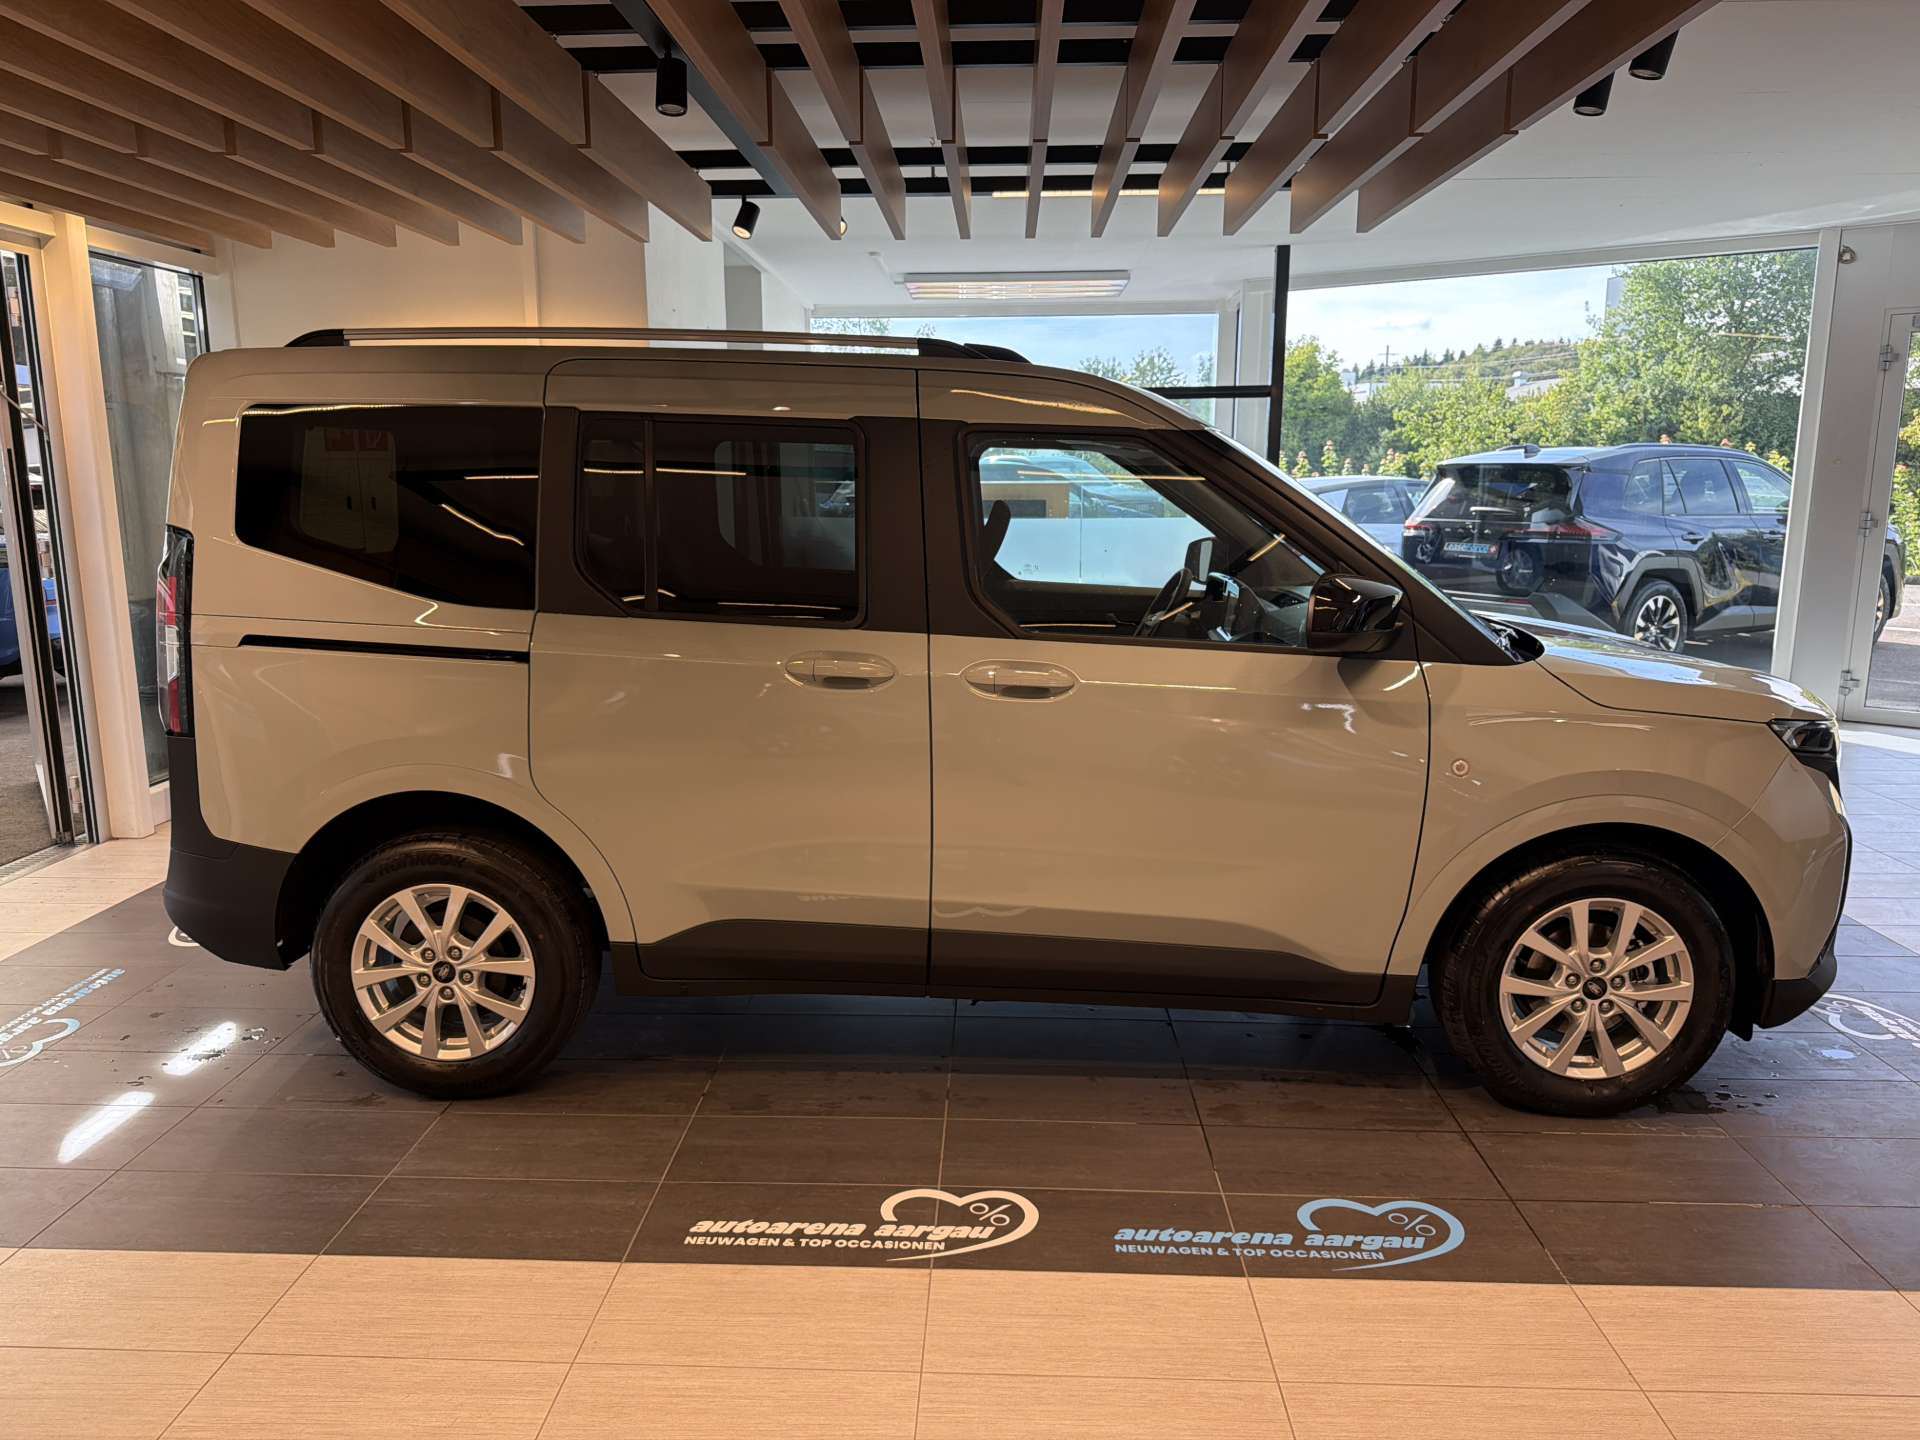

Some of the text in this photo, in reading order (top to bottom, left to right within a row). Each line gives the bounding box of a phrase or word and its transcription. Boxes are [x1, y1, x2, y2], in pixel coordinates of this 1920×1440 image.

[689, 1219, 996, 1240] autoarena aargau
[1114, 1227, 1425, 1250] autoarena aargau
[684, 1236, 946, 1250] NEUWAGEN & TOP OCCASIONEN
[1114, 1244, 1384, 1260] NEUWAGEN & TOP OCCASIONEN
